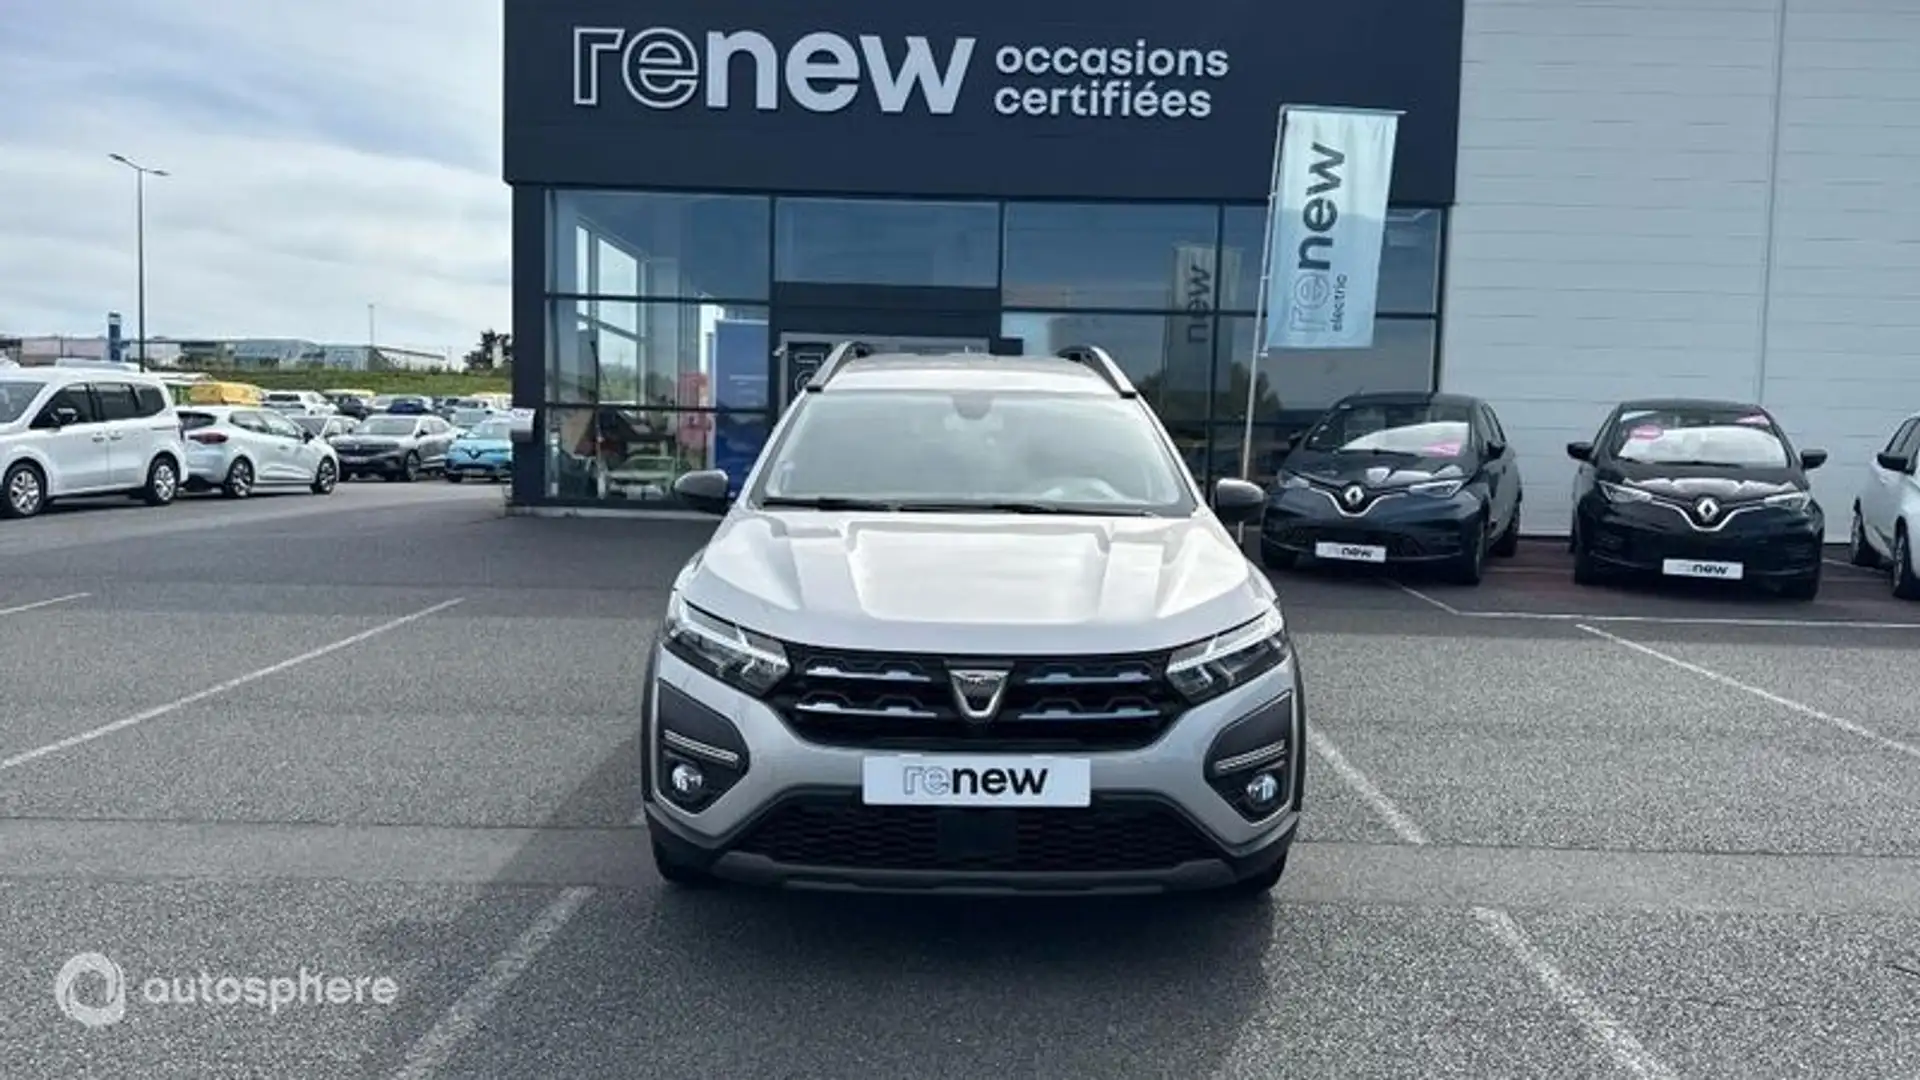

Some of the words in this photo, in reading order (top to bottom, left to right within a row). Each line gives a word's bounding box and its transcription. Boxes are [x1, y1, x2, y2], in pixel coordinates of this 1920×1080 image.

[573, 26, 977, 114] renew
[995, 38, 1230, 76] occasions
[994, 79, 1213, 118] certifiées
[1289, 142, 1346, 334] renew
[1329, 274, 1349, 333] electric
[902, 765, 1049, 796] renew
